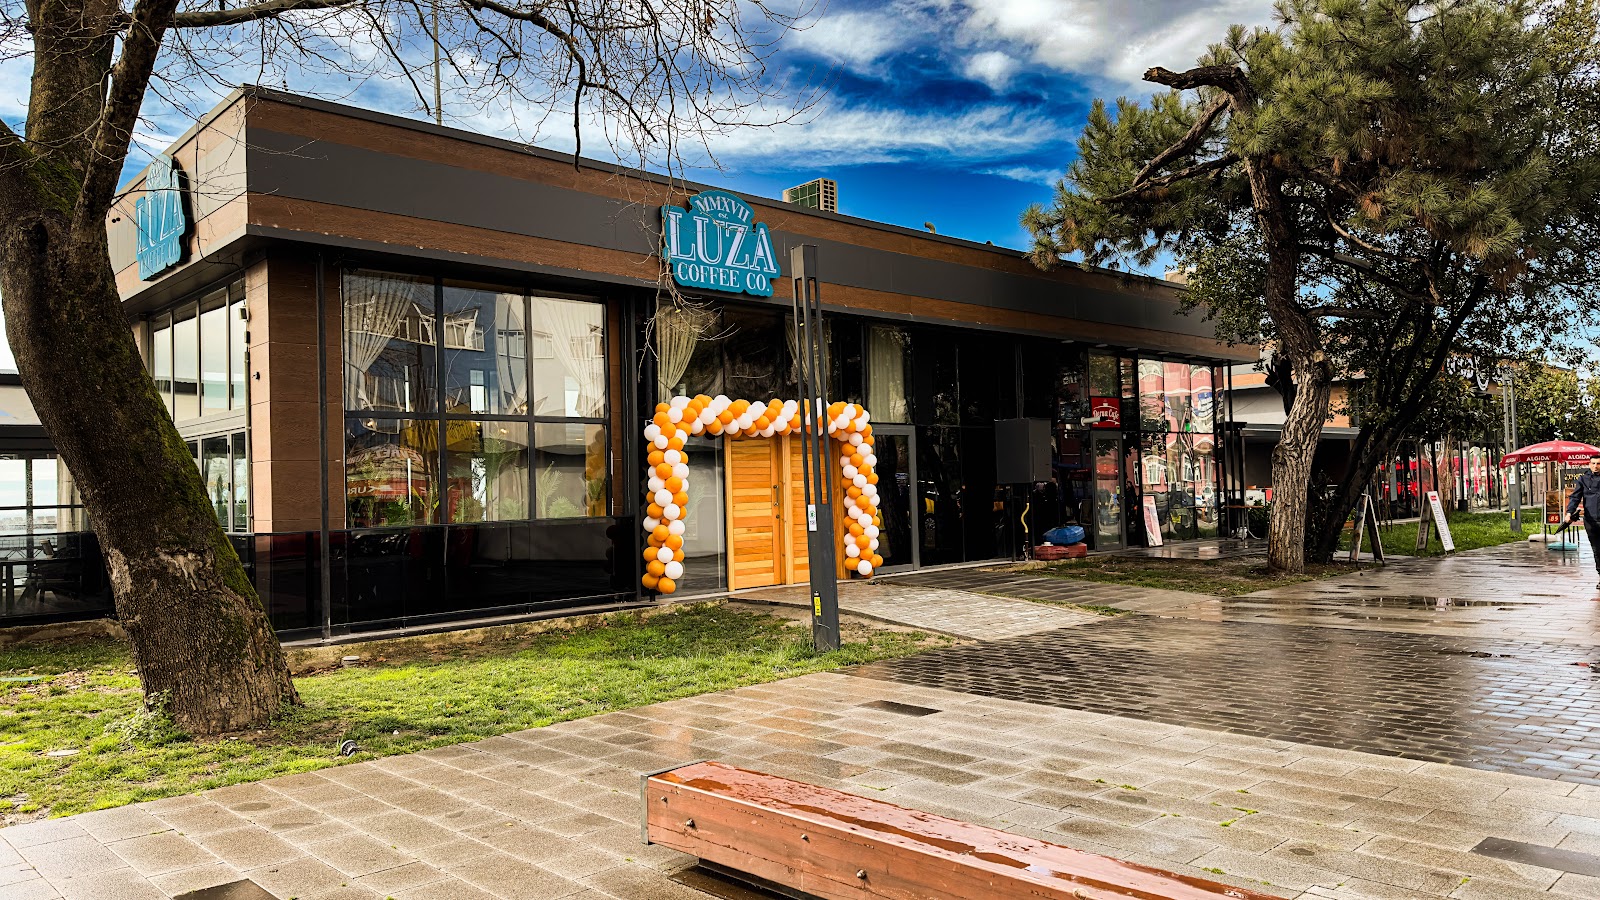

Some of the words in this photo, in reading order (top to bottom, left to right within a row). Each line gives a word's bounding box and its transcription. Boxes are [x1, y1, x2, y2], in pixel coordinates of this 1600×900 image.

[138, 178, 183, 254] LUZA
[695, 196, 750, 222] MMXVII
[668, 211, 776, 273] LUZA
[677, 262, 740, 287] COFFEE
[746, 272, 770, 292] CO.
